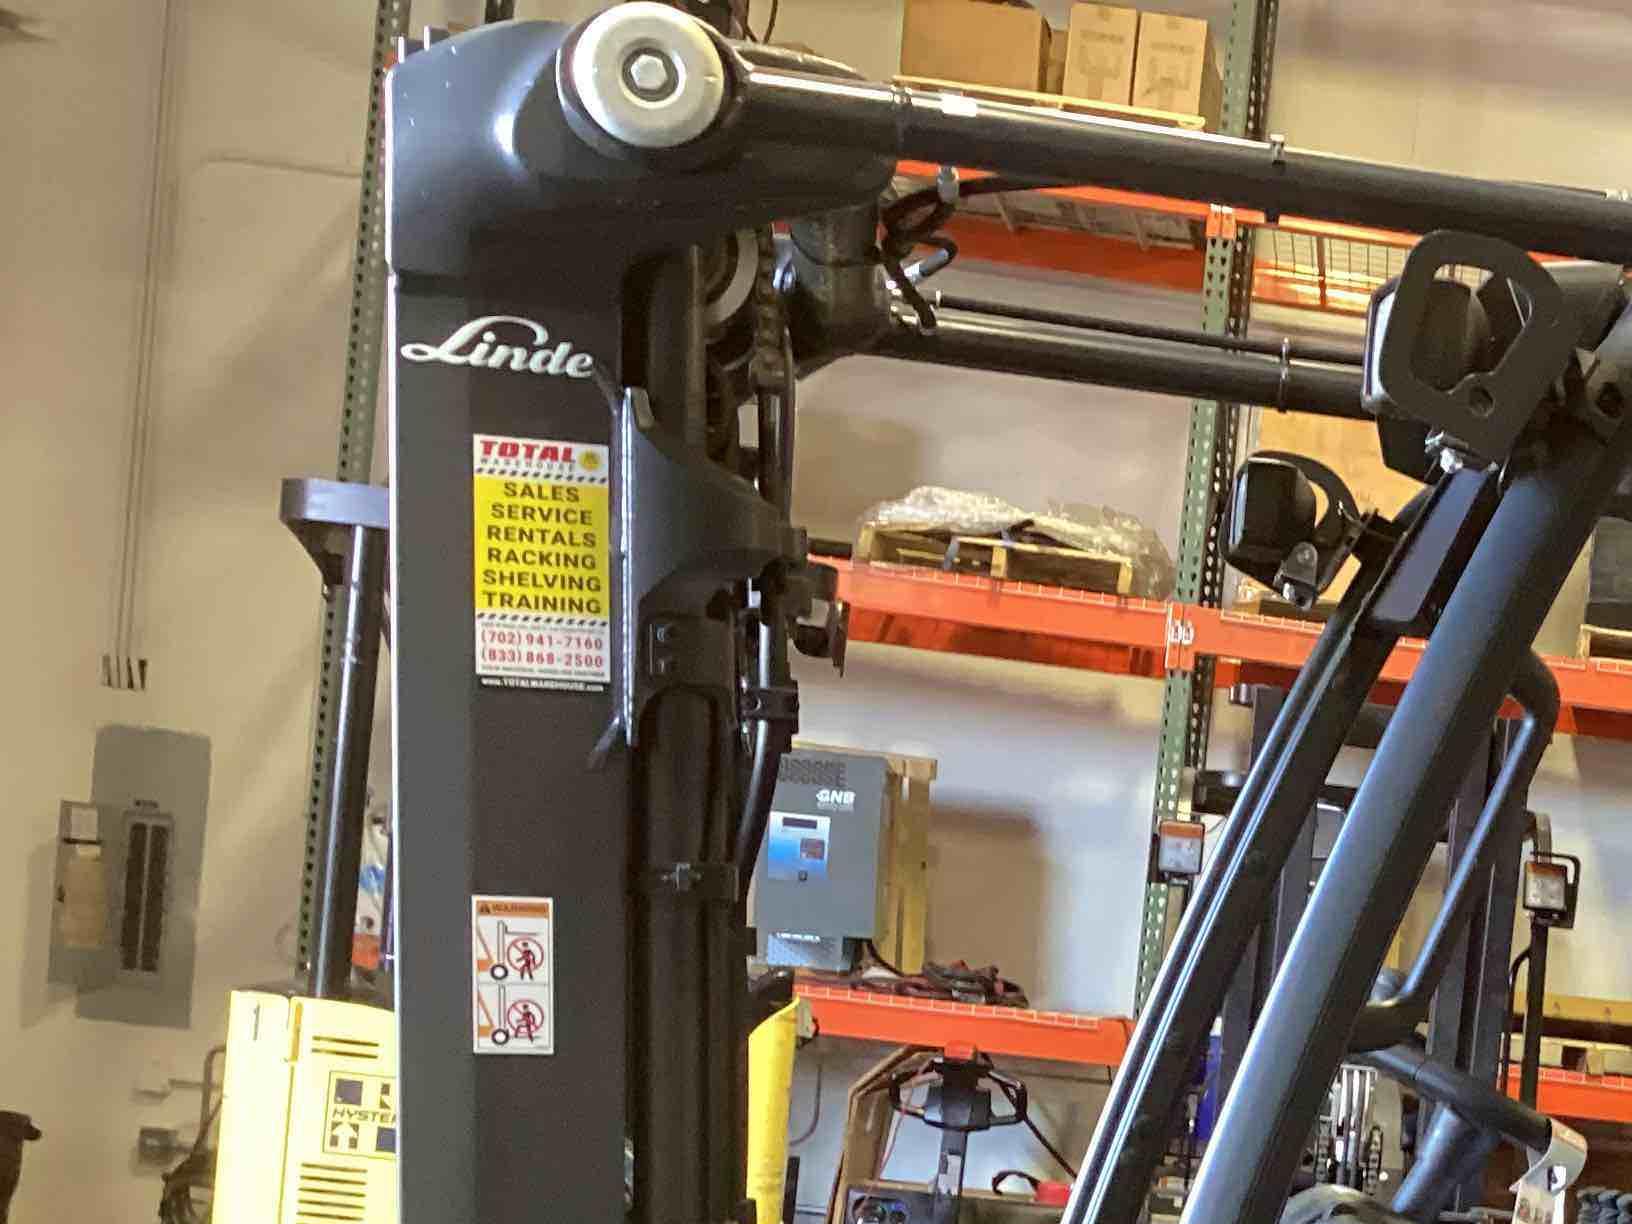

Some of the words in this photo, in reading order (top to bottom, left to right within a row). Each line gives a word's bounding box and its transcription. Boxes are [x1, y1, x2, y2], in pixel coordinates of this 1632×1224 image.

[400, 315, 593, 378] Linde
[480, 440, 576, 464] TOTAL
[504, 481, 580, 503] SALES
[490, 502, 593, 526] SERVICE
[487, 524, 597, 548] RENTALS
[487, 547, 597, 571] RACKING
[482, 569, 602, 593] SHELVING
[481, 590, 602, 614] TRAINING
[332, 1107, 397, 1124] HYSTE
